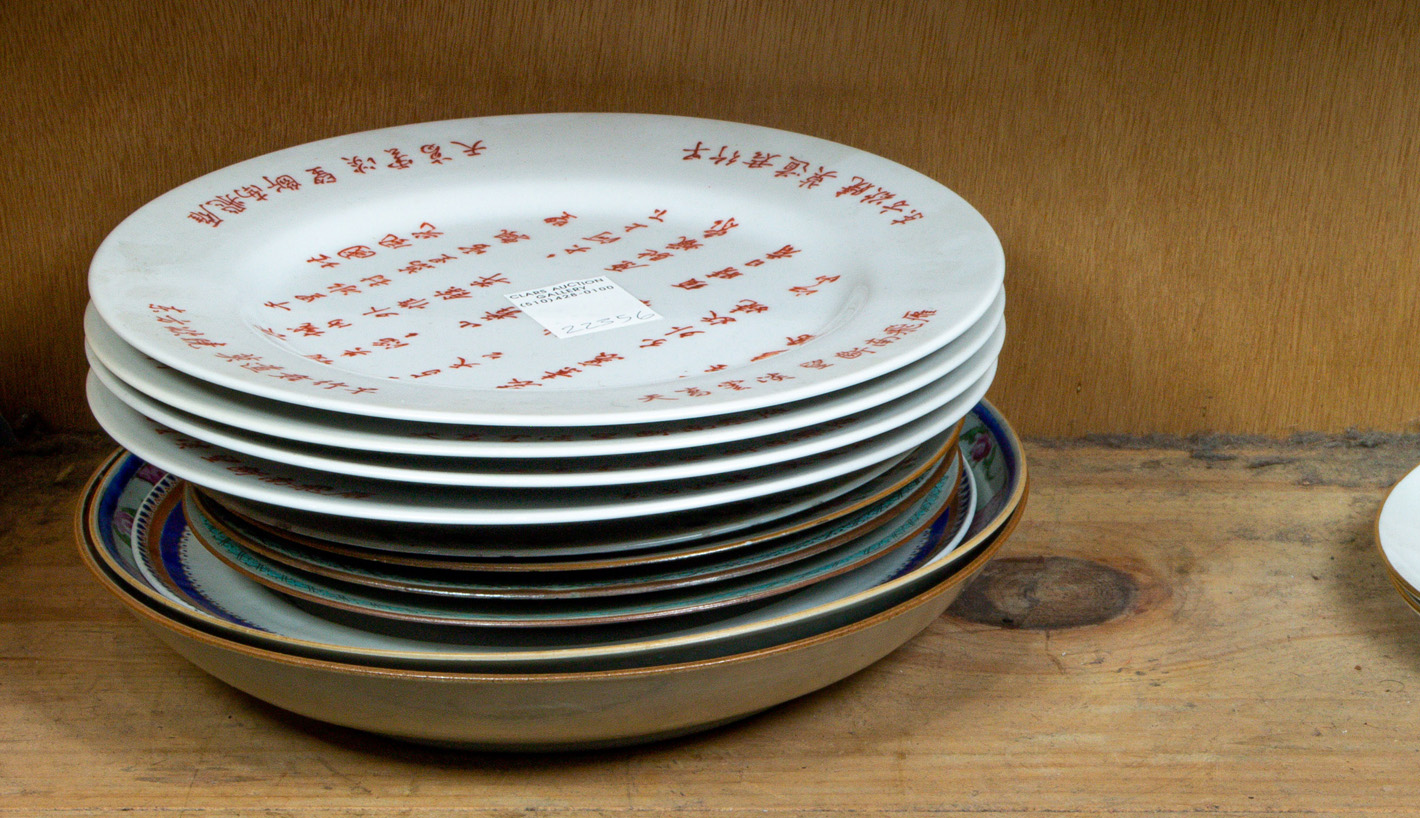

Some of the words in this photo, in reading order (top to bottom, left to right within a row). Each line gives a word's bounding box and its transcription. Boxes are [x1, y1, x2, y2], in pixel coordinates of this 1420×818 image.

[510, 288, 548, 300] CLARS
[552, 277, 605, 292] AUCTION
[536, 286, 587, 299] GALLERY
